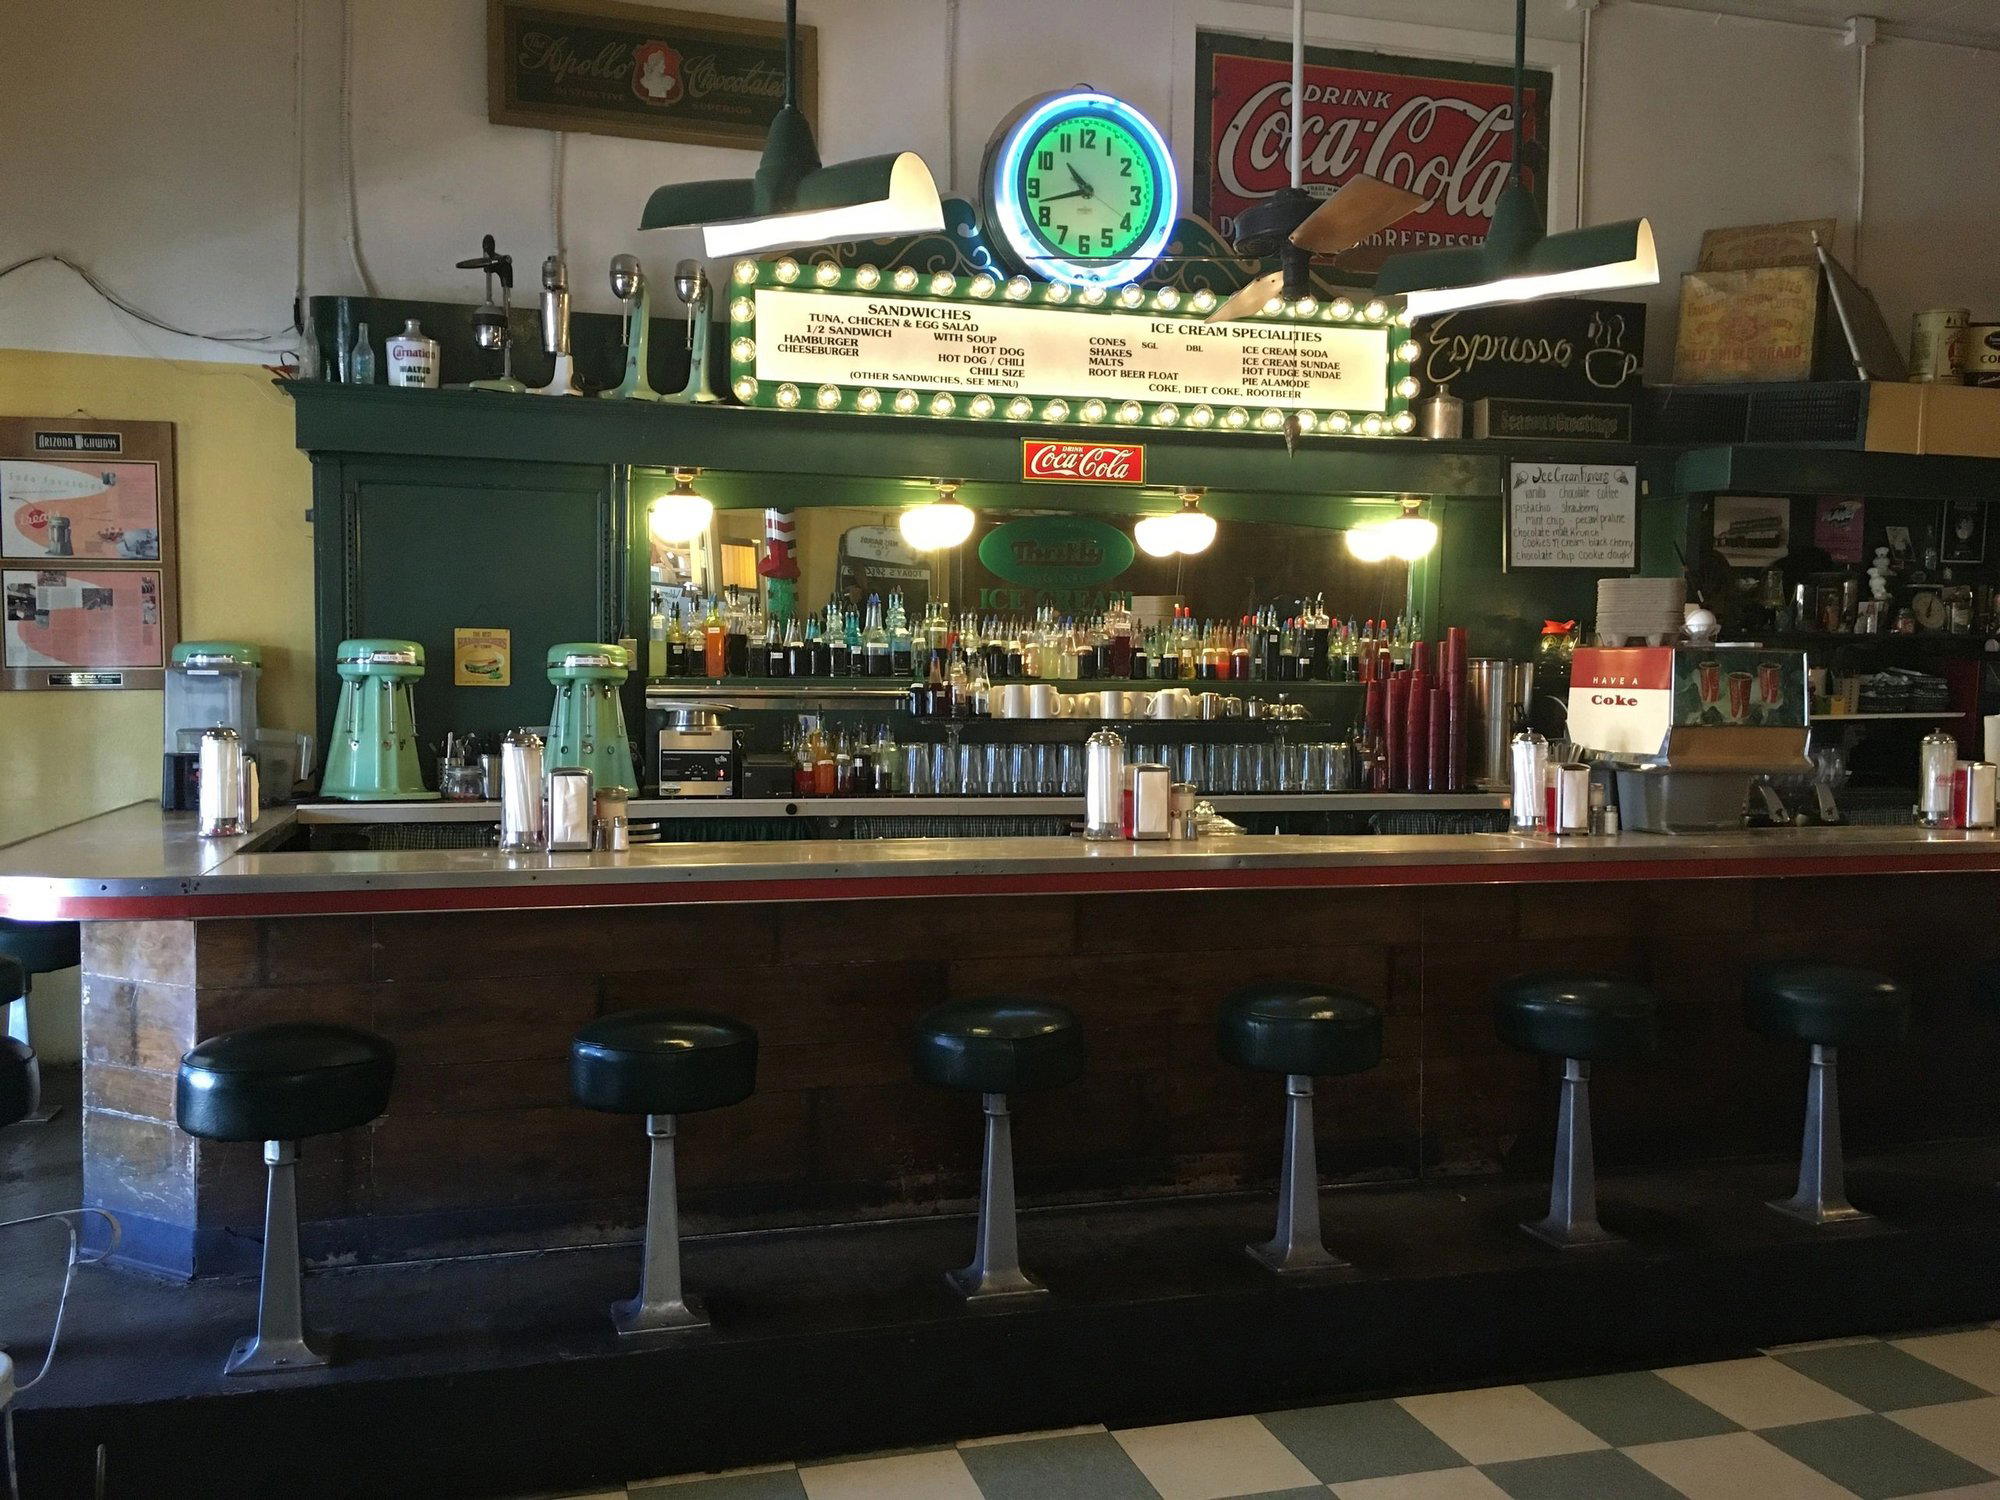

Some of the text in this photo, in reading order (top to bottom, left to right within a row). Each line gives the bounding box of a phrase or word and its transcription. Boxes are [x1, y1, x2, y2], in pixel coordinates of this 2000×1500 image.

[1304, 84, 1393, 109] DRINK
[1060, 133, 1071, 153] 11
[1080, 129, 1096, 149] 12
[1106, 137, 1112, 156] 1
[1038, 151, 1053, 170] 10
[1120, 158, 1132, 177] 2
[1028, 178, 1040, 198] 9
[1130, 186, 1142, 206] 3
[1039, 206, 1051, 227] 8
[1120, 213, 1132, 232] 4
[1057, 225, 1068, 245] 7
[1101, 228, 1113, 248] 5
[1079, 235, 1090, 254] 6
[868, 304, 971, 320] SANDWICHES
[848, 316, 900, 327] CHICKEN
[903, 320, 912, 328] &
[916, 321, 939, 329] EGG
[942, 322, 979, 332] SALAD
[784, 334, 859, 346] HAMBURGER
[806, 325, 997, 344] 1/2 SANDWICH WITH SOUP
[1151, 323, 1322, 342] ICE CREAM SPECIALITIES
[777, 344, 859, 356] CHEESEBURGER
[1089, 337, 1126, 346] CONES
[1141, 341, 1158, 349] SGL
[393, 345, 436, 360] Carnation
[972, 346, 1025, 357] HOT DOG
[1090, 347, 1132, 357] SHAKES
[1242, 346, 1328, 358] ICE CREAM SODA
[938, 354, 961, 362] HOT
[963, 355, 987, 364] DOG
[997, 357, 1024, 366] CHILI
[1088, 357, 1124, 367] MALTS
[1242, 357, 1340, 370] ICE CREAM SUNDAE
[400, 366, 431, 374] MALTED
[969, 367, 1025, 378] CHILI SIZE
[1088, 368, 1179, 380] ROOT BEER FLOAT
[1242, 367, 1342, 379] HOT FUDGE SUNDAE
[406, 375, 426, 383] MILK
[850, 371, 889, 380] (OTHER
[987, 379, 1019, 388] MENU)
[1242, 378, 1310, 388] PIE ALAMODE
[1149, 384, 1181, 394] COKE,
[1184, 385, 1208, 394] DIET
[1246, 389, 1301, 398] ROOTBEER
[38, 434, 74, 448] ARIZONA
[1031, 445, 1134, 478] Coca-Cola
[978, 588, 1026, 609] ICE
[1593, 677, 1625, 685] HAVE
[1591, 694, 1638, 706] Coke
